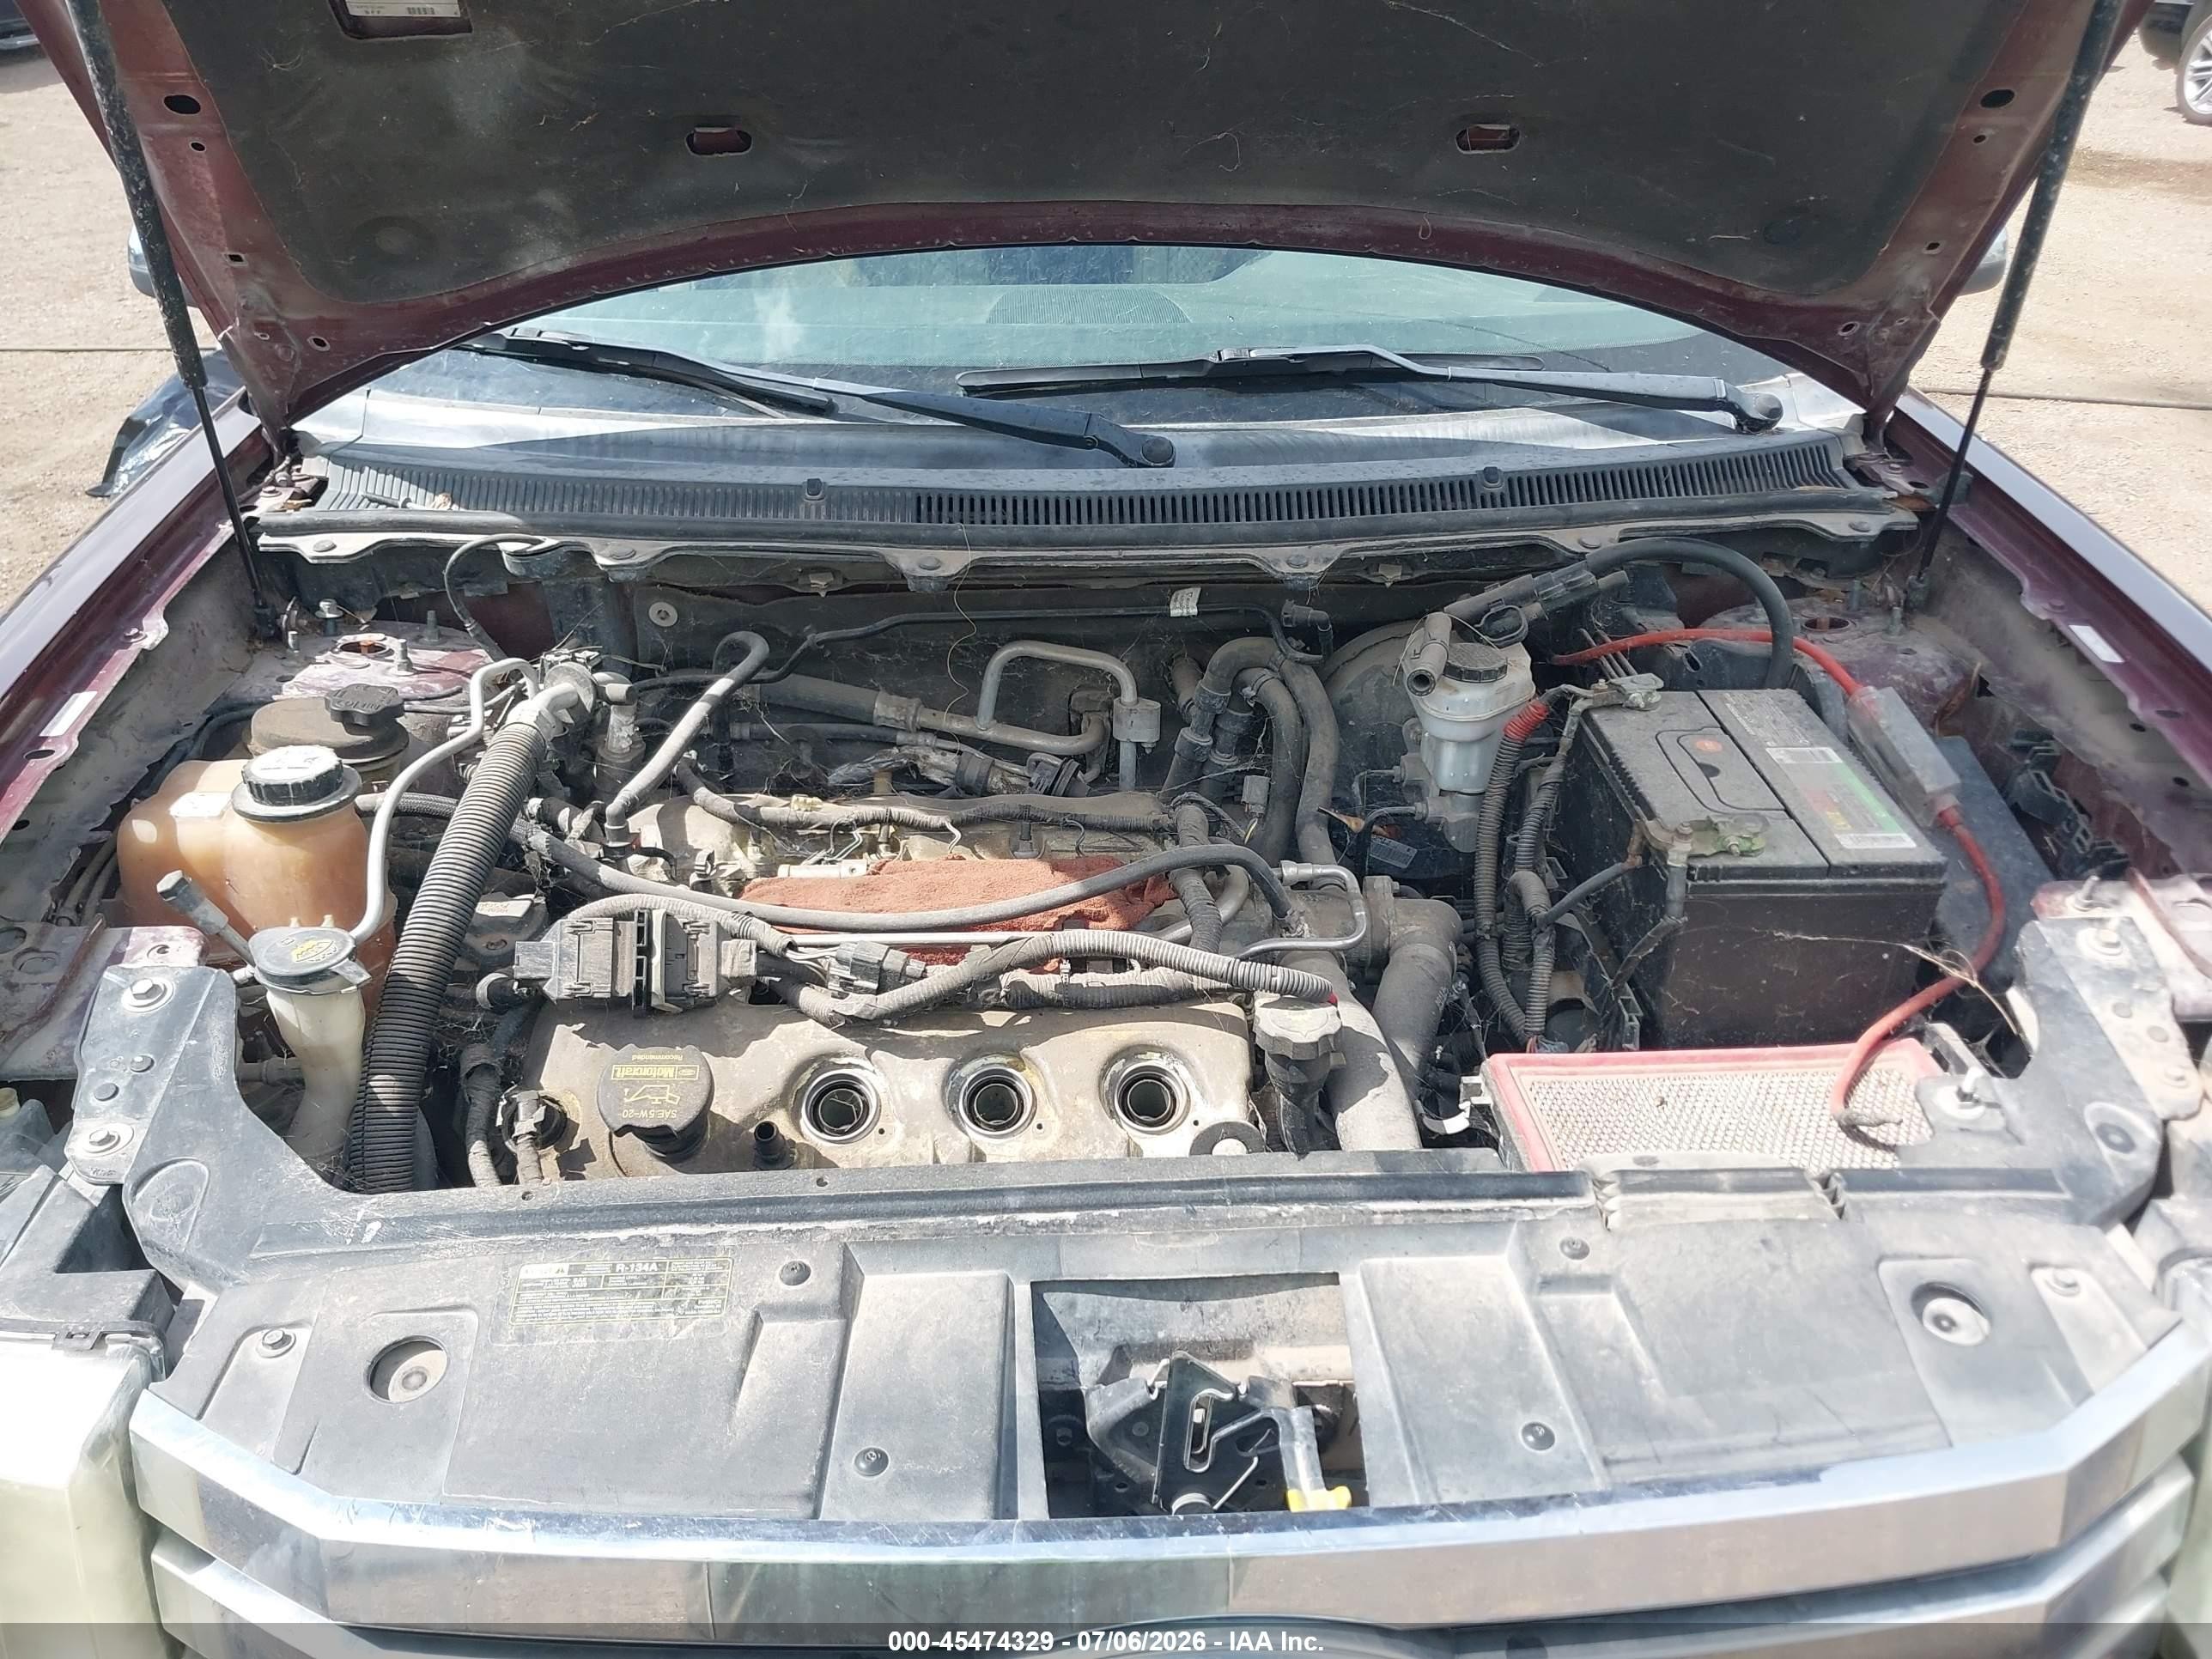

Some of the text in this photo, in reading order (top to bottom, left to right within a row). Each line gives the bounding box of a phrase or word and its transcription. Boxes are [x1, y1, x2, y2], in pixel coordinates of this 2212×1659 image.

[617, 1066, 675, 1079] Motorcraft
[622, 1109, 678, 1119] SAE 5W-20
[616, 1262, 659, 1273] R-134A
